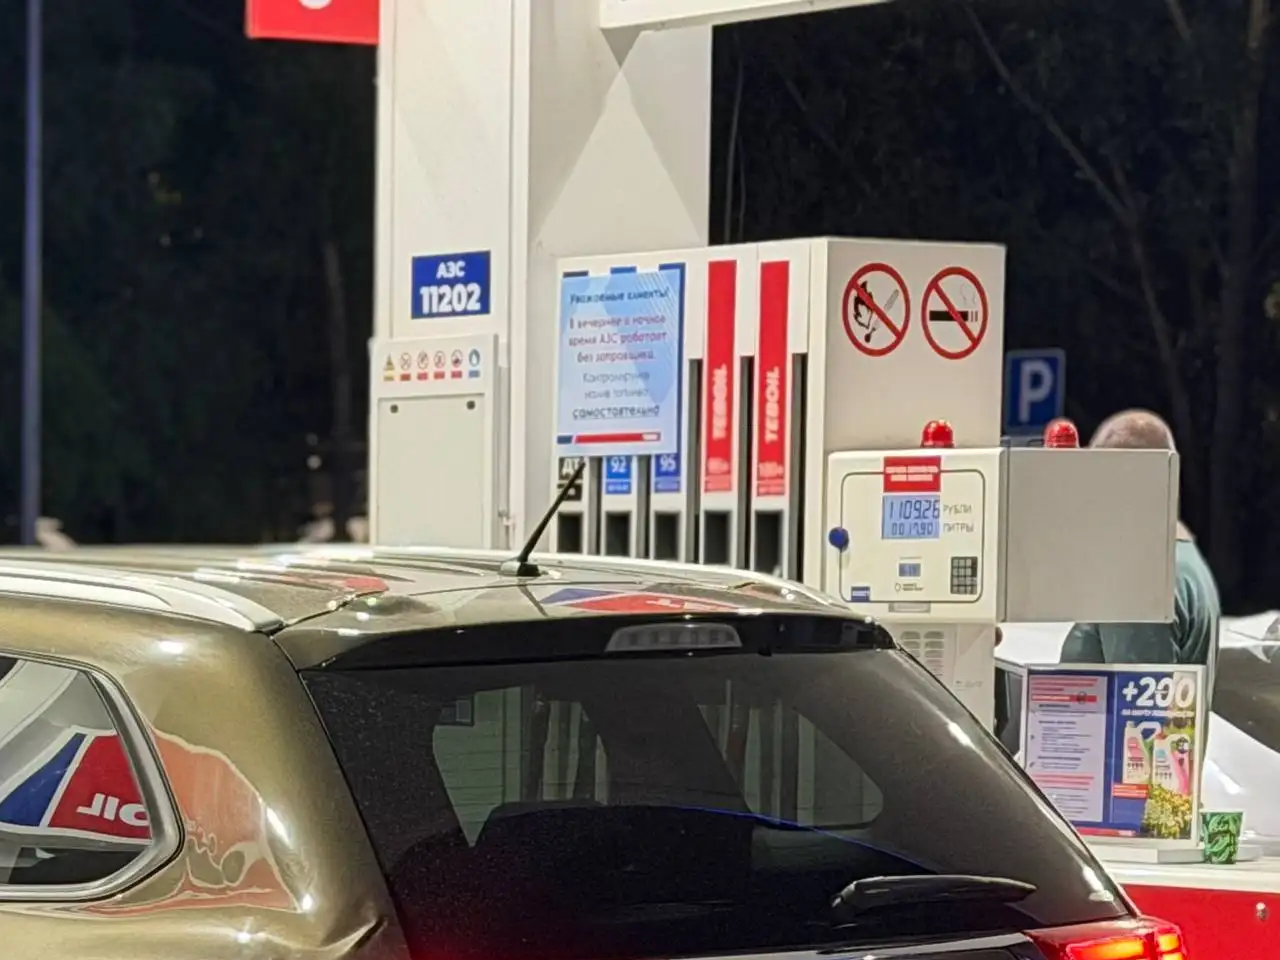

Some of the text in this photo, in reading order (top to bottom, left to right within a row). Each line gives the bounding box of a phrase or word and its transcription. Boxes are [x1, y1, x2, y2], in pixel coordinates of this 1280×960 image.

[436, 260, 466, 279] АЗС
[419, 282, 481, 315] 11202
[632, 314, 666, 325] ночное
[569, 330, 667, 348] время АЗС работает
[577, 351, 593, 364] без
[1018, 359, 1053, 423] P
[572, 405, 660, 420] самостоятельно
[765, 366, 780, 445] TEBOIL
[611, 456, 628, 474] 92
[660, 454, 677, 473] 95
[943, 503, 972, 515] РУБЛИ
[943, 522, 975, 533] ЛИТРЫ
[1122, 676, 1195, 708] +200
